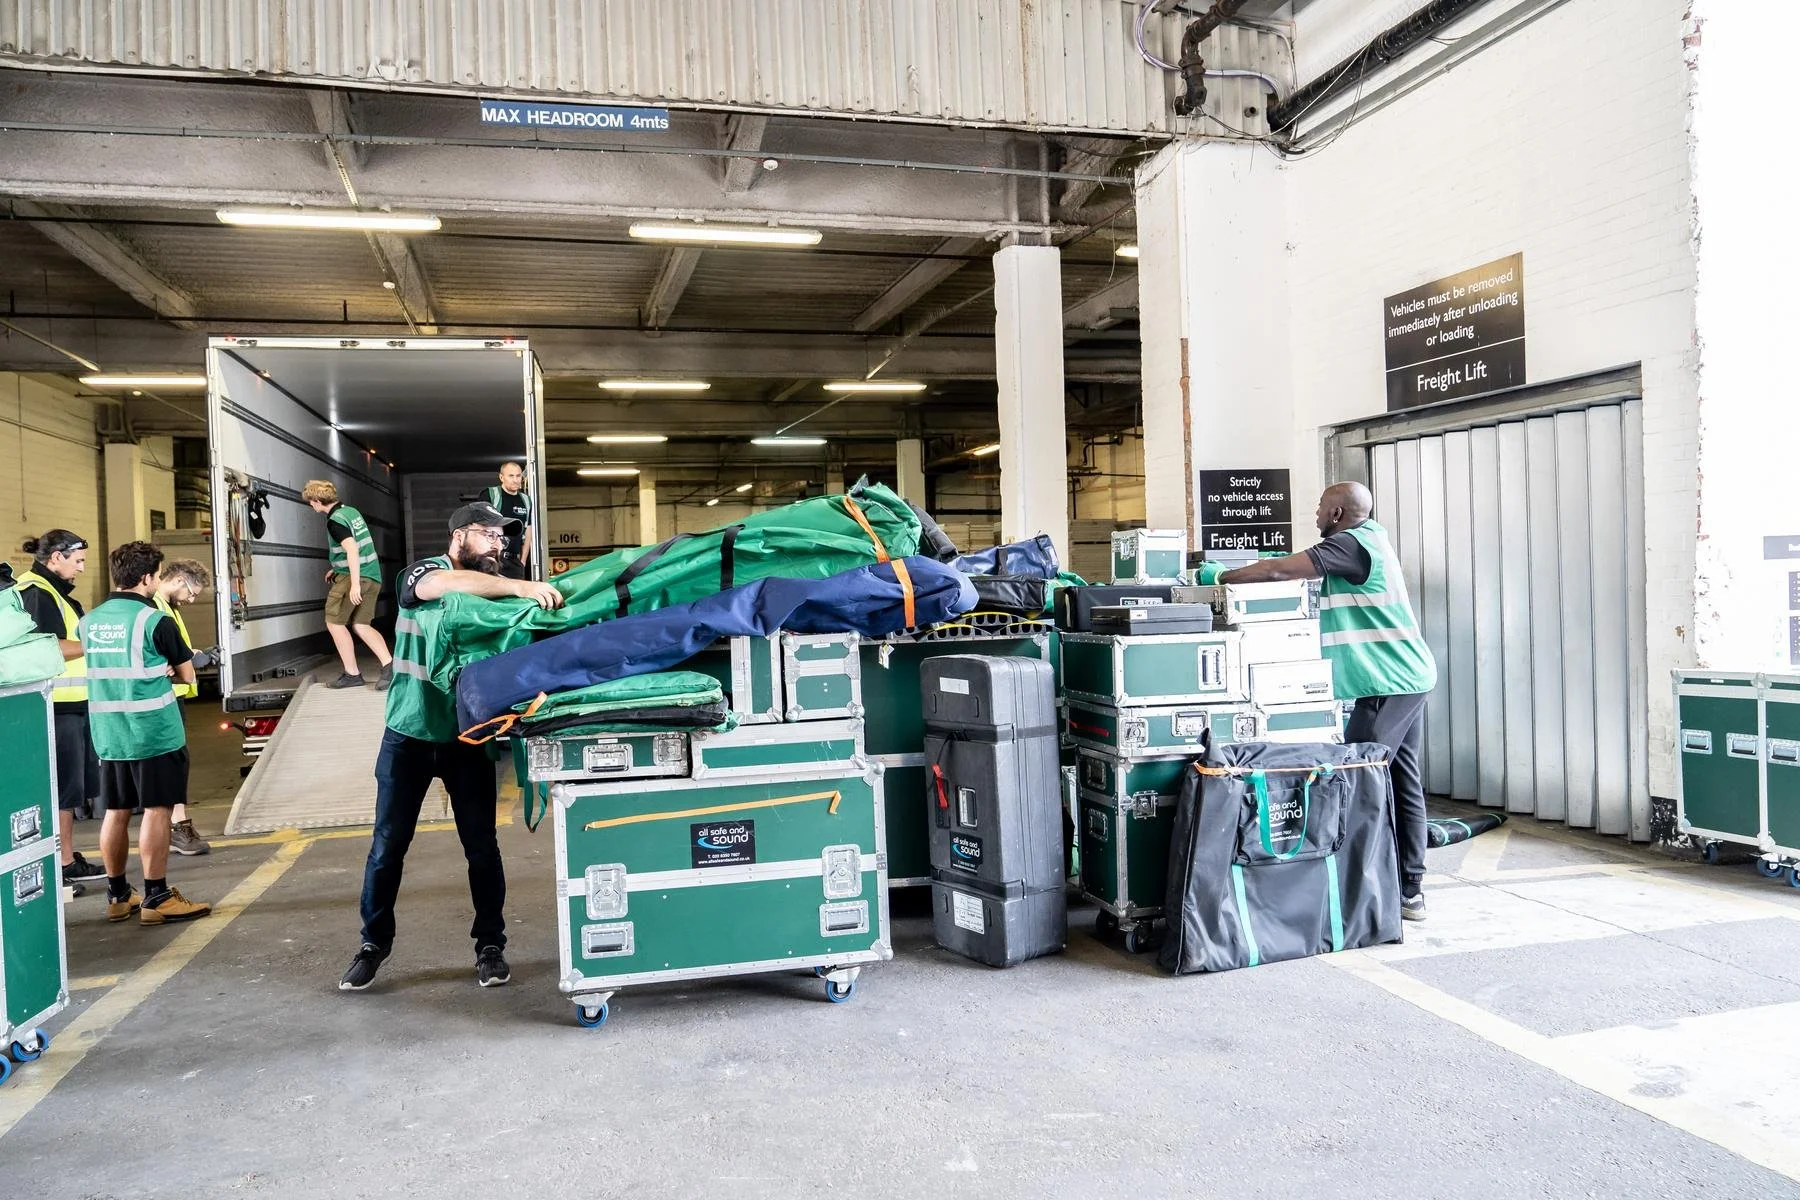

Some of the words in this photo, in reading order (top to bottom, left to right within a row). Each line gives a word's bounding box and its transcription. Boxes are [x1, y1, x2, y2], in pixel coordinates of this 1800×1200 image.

[482, 108, 520, 124] MAX
[527, 110, 624, 128] HEADROOM
[630, 115, 669, 129] 4mts
[1391, 299, 1425, 318] Vehicles
[1427, 291, 1451, 307] must
[1453, 285, 1465, 299] be
[1468, 267, 1513, 293] removed
[1388, 312, 1440, 338] immediately
[1443, 307, 1466, 322] after
[1468, 291, 1518, 315] unloading
[1426, 335, 1437, 347] or
[1440, 325, 1474, 344] loading
[1417, 368, 1461, 392] Freight
[1465, 360, 1487, 382] Lift
[1229, 476, 1262, 489] Strictly
[1208, 494, 1220, 502] no
[1222, 491, 1254, 502] vehicle
[1255, 493, 1284, 501] access
[1222, 506, 1257, 519] through
[1260, 505, 1272, 516] lift
[1210, 532, 1259, 550] Freight
[1263, 531, 1285, 547] Lift
[100, 627, 127, 639] sound
[1269, 803, 1281, 812] afe
[1281, 799, 1297, 809] and
[1269, 805, 1303, 823] sound
[698, 828, 709, 837] all
[710, 827, 728, 836] safe
[729, 825, 745, 835] and
[712, 831, 749, 845] sound
[959, 839, 969, 847] safe
[969, 841, 978, 849] and
[960, 845, 980, 858] sound
